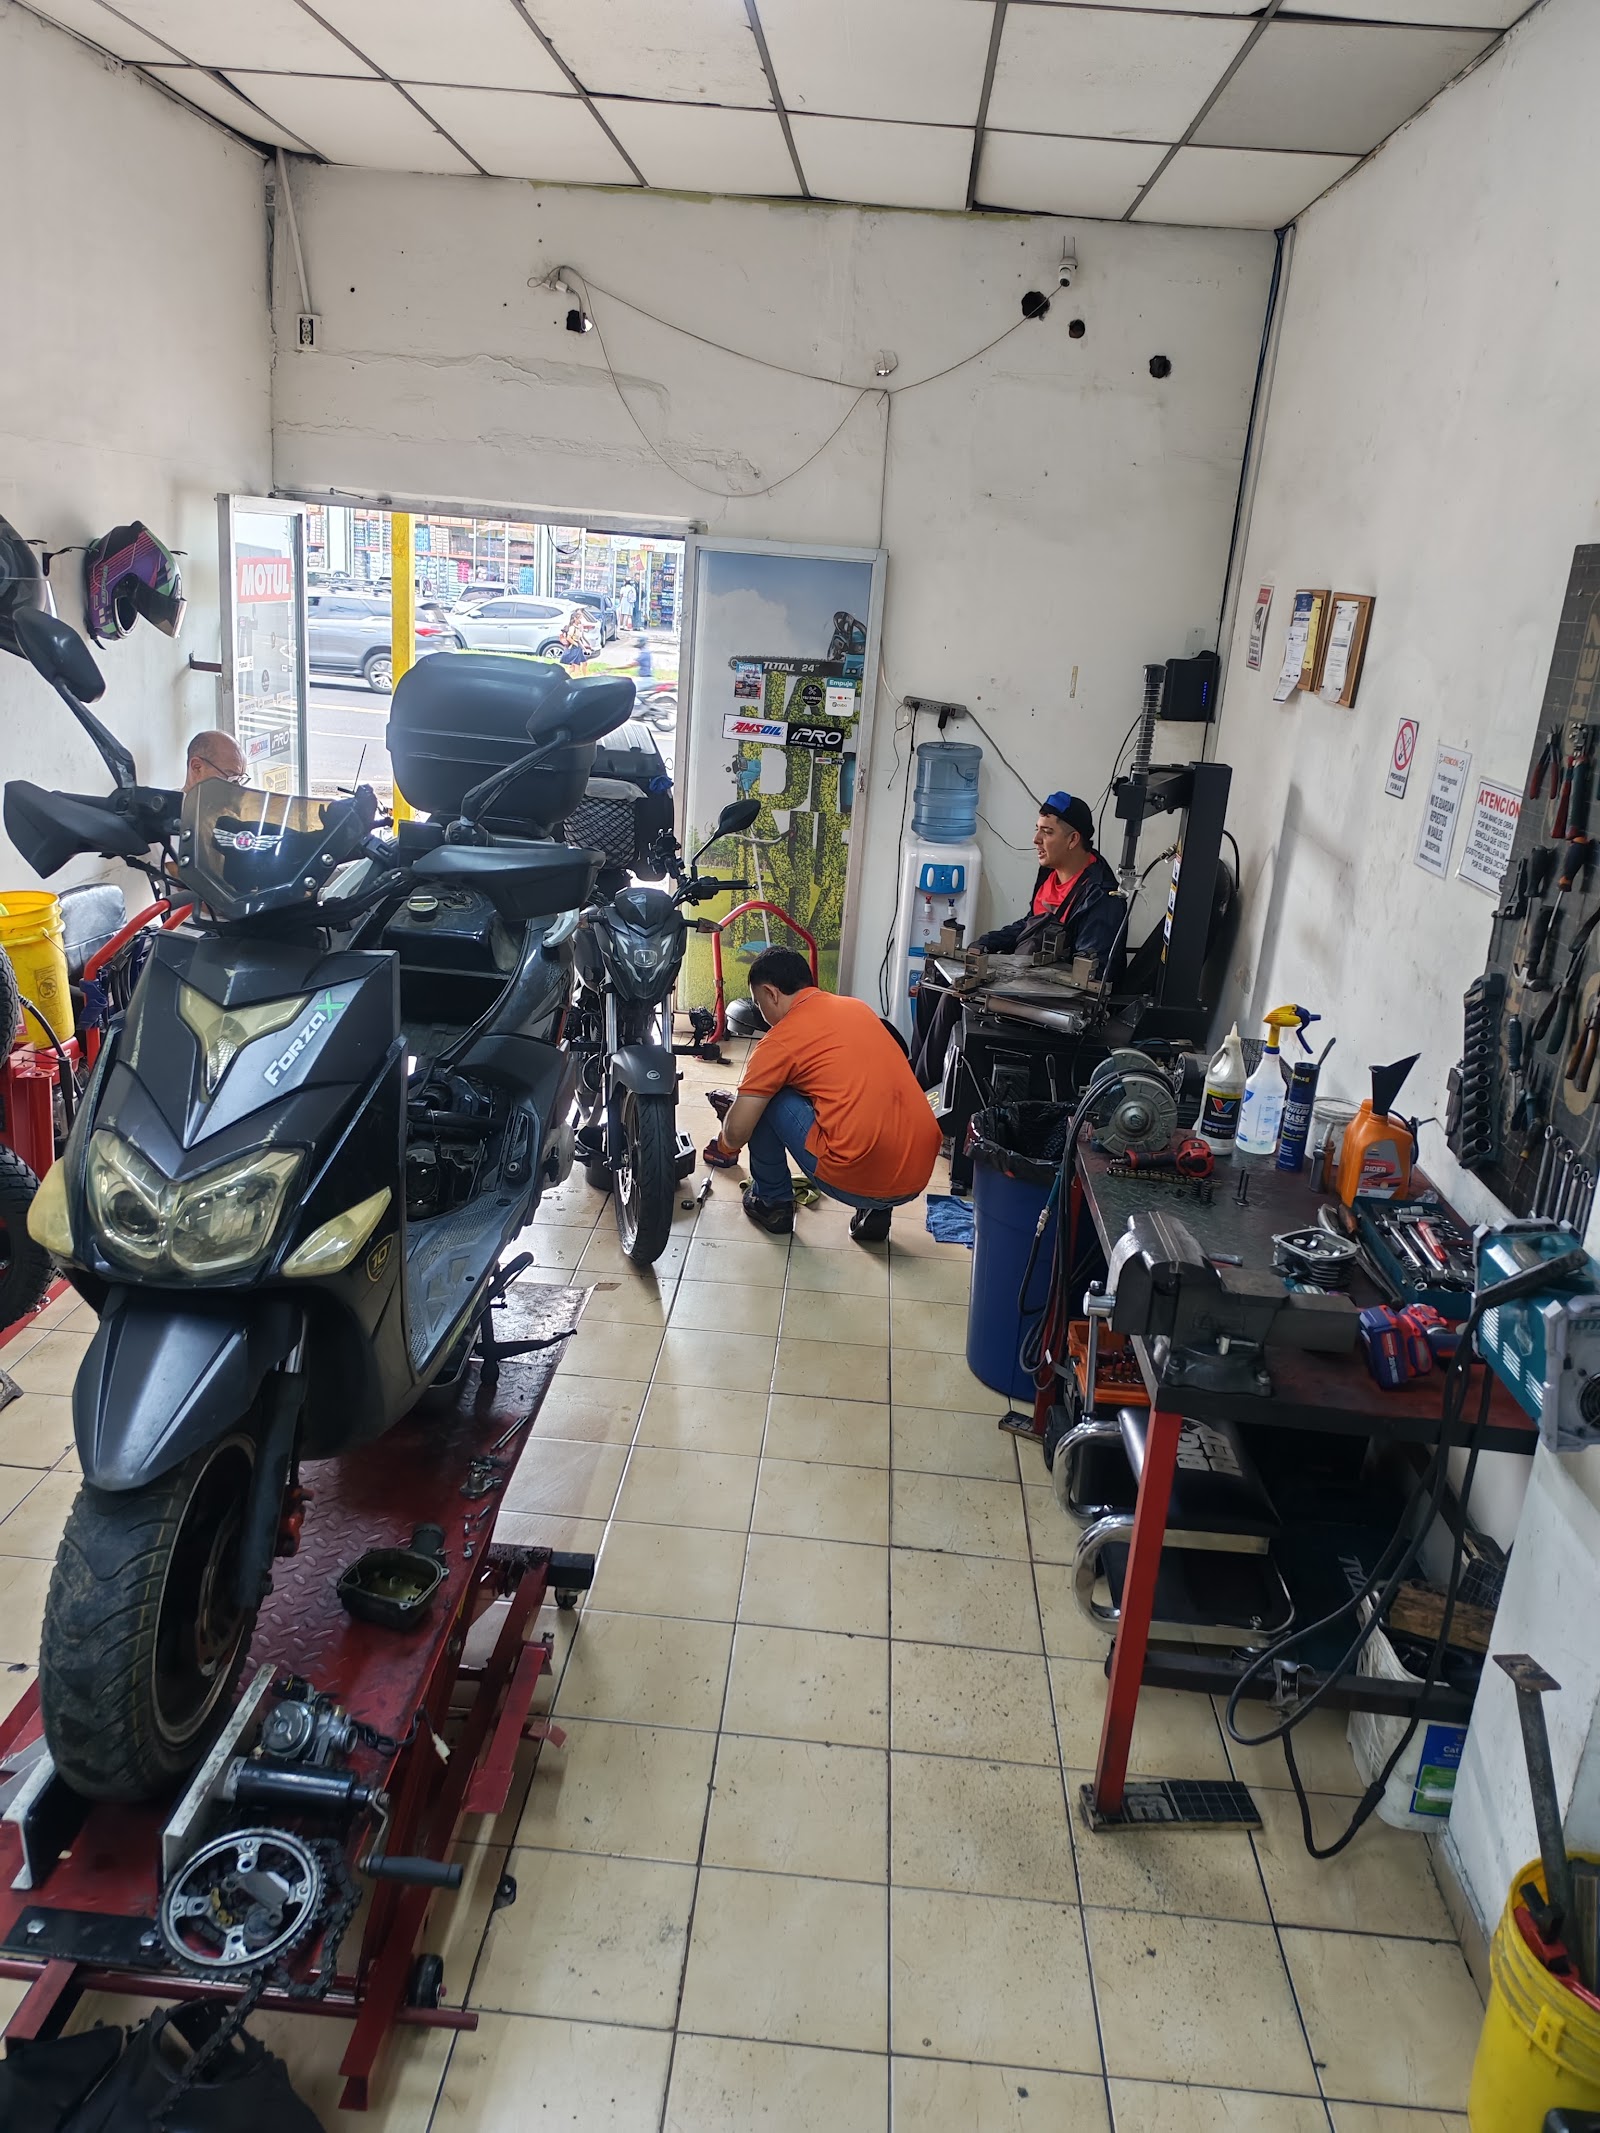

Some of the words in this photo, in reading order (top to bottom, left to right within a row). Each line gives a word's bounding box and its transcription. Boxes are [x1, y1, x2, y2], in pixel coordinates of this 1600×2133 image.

[240, 563, 289, 596] MOTUL
[763, 661, 795, 672] TOTAL
[731, 721, 783, 736] AMSOIL
[1478, 790, 1521, 819] ATENCIÓN
[1286, 1104, 1310, 1116] THIUM
[1285, 1112, 1306, 1124] EASE
[1364, 1165, 1387, 1173] RIDER
